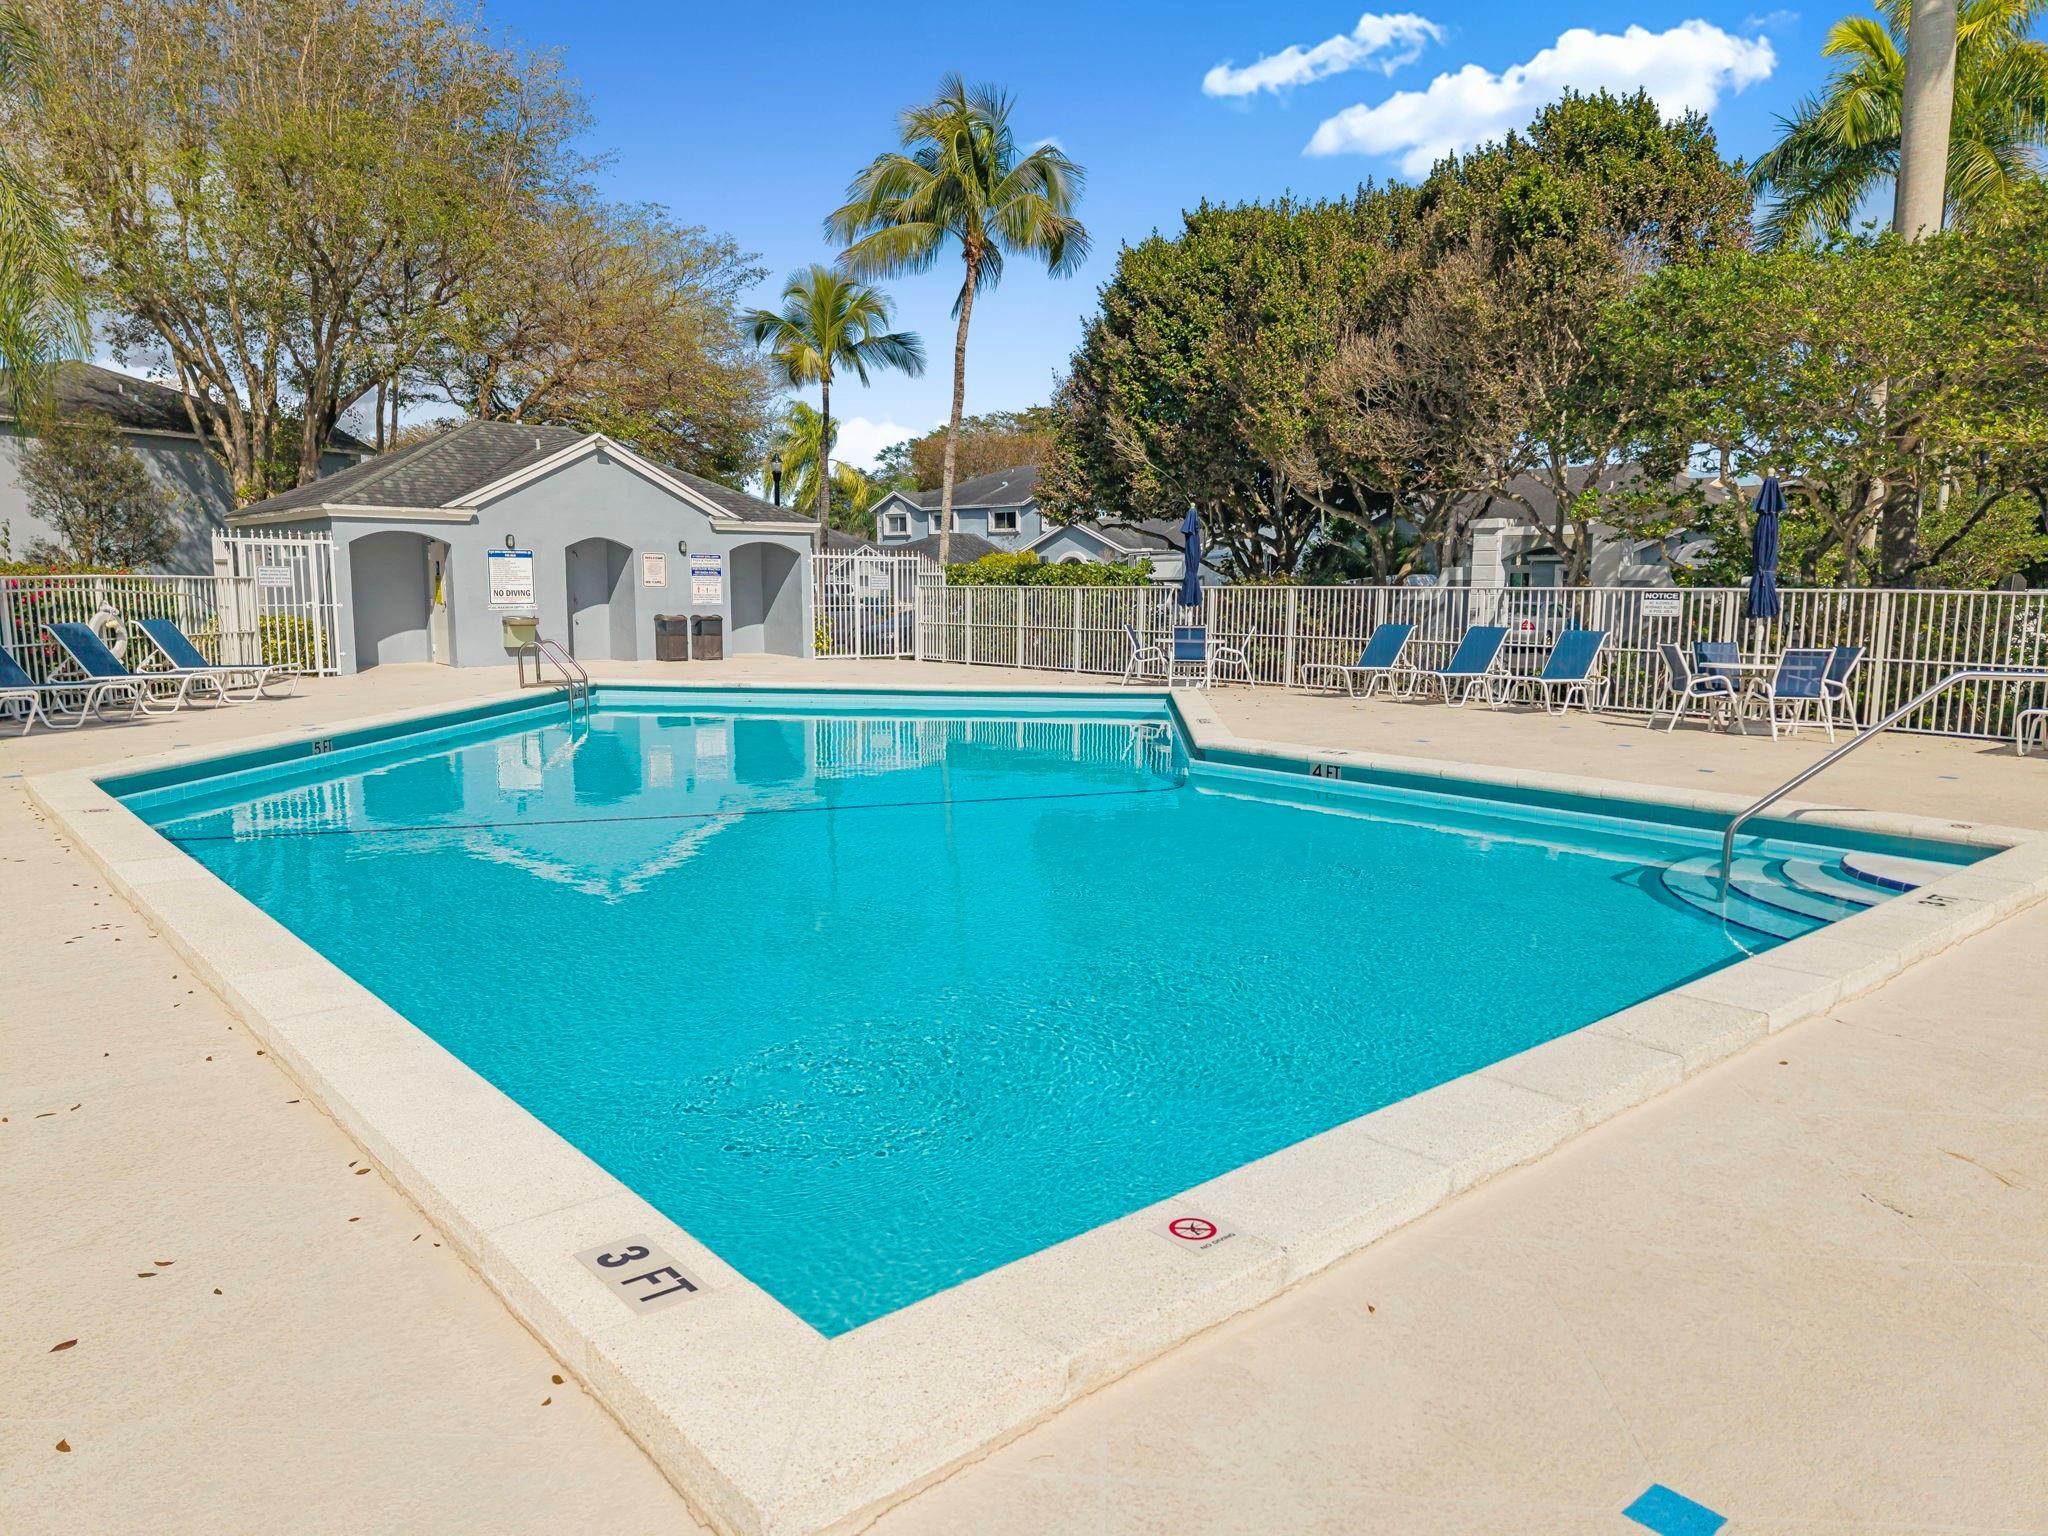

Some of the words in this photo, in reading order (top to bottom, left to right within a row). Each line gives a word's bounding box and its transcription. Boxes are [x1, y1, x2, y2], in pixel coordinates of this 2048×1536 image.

[493, 589, 504, 597] NO
[506, 589, 531, 597] DIVING
[314, 741, 321, 755] 5
[323, 739, 332, 753] FT
[1312, 763, 1322, 778] 4
[1326, 764, 1341, 779] FT
[1200, 1242, 1212, 1250] NO
[596, 1245, 650, 1268] 3
[620, 1266, 699, 1302] FT
